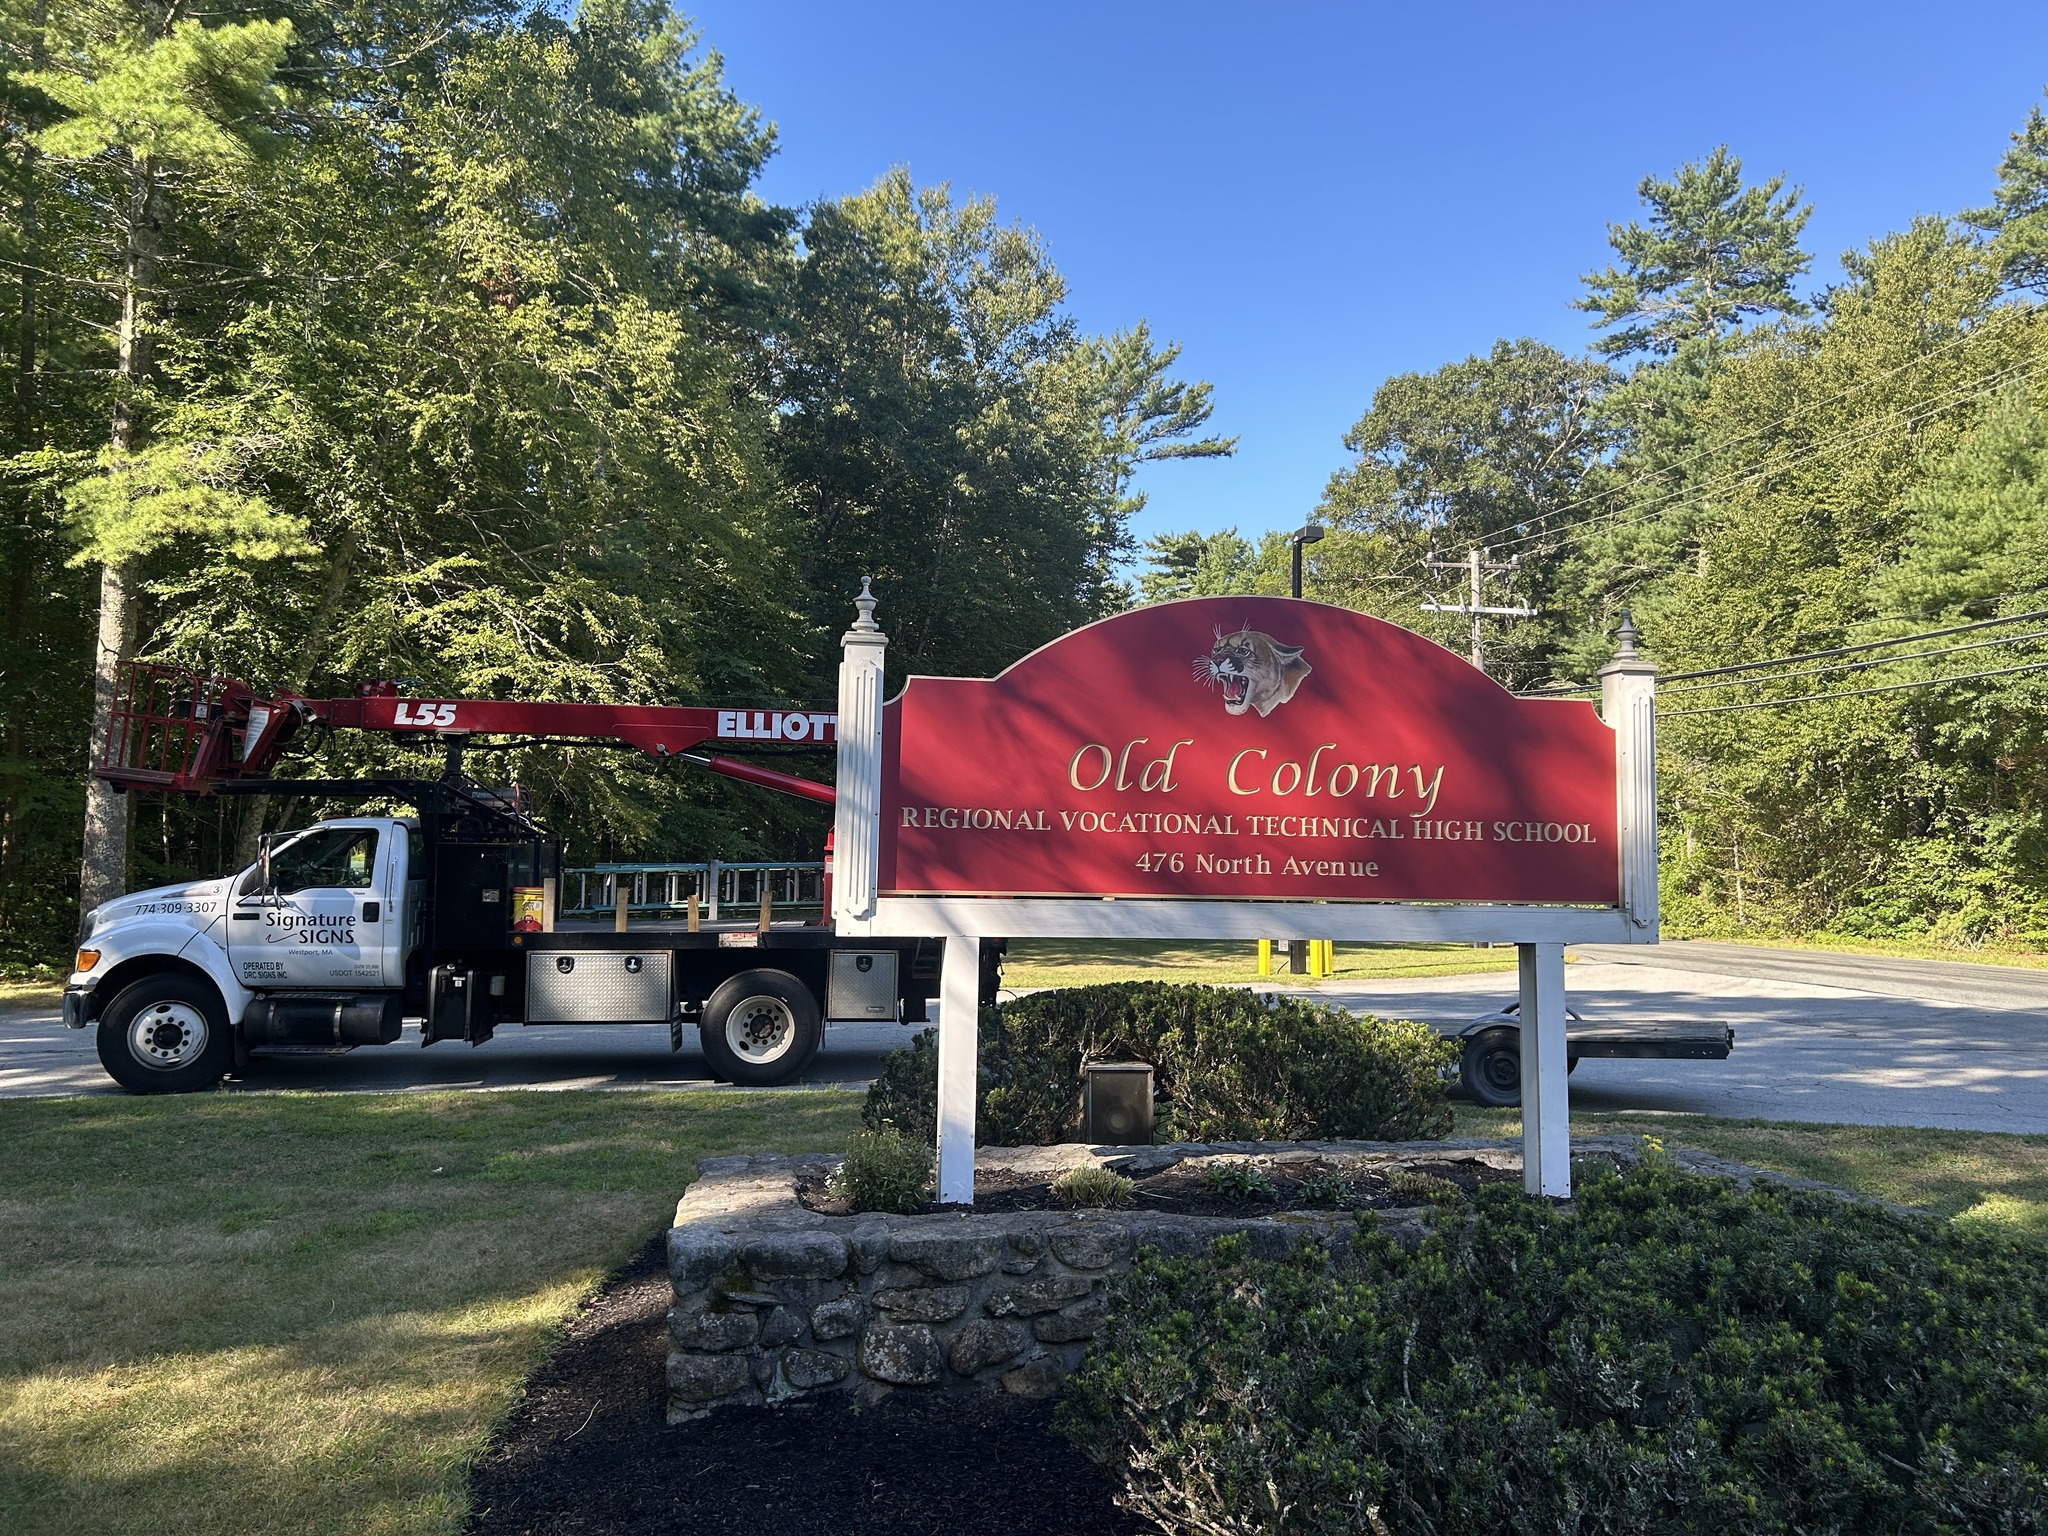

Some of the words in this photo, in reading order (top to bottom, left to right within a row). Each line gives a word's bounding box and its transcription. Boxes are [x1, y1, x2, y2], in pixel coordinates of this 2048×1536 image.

[393, 702, 457, 727] L55
[1067, 736, 1194, 793] Old
[1225, 742, 1445, 818] Colony
[900, 806, 1051, 832] REGIONAL
[1058, 810, 1240, 837] VOCATIONAL
[1246, 814, 1405, 841] TECHNICAL
[1412, 819, 1484, 842] HIGH
[1492, 820, 1597, 844] SCHOOL
[1134, 851, 1186, 874] 476
[1195, 852, 1272, 876] North
[1280, 854, 1380, 878] Avenue
[265, 912, 357, 931] Signature
[298, 929, 355, 944] SIGNS
[242, 961, 275, 971] OPERATED
[275, 961, 285, 971] BY
[243, 970, 257, 979] DRC
[258, 970, 276, 980] SIGNS
[329, 969, 353, 977] USDOT
